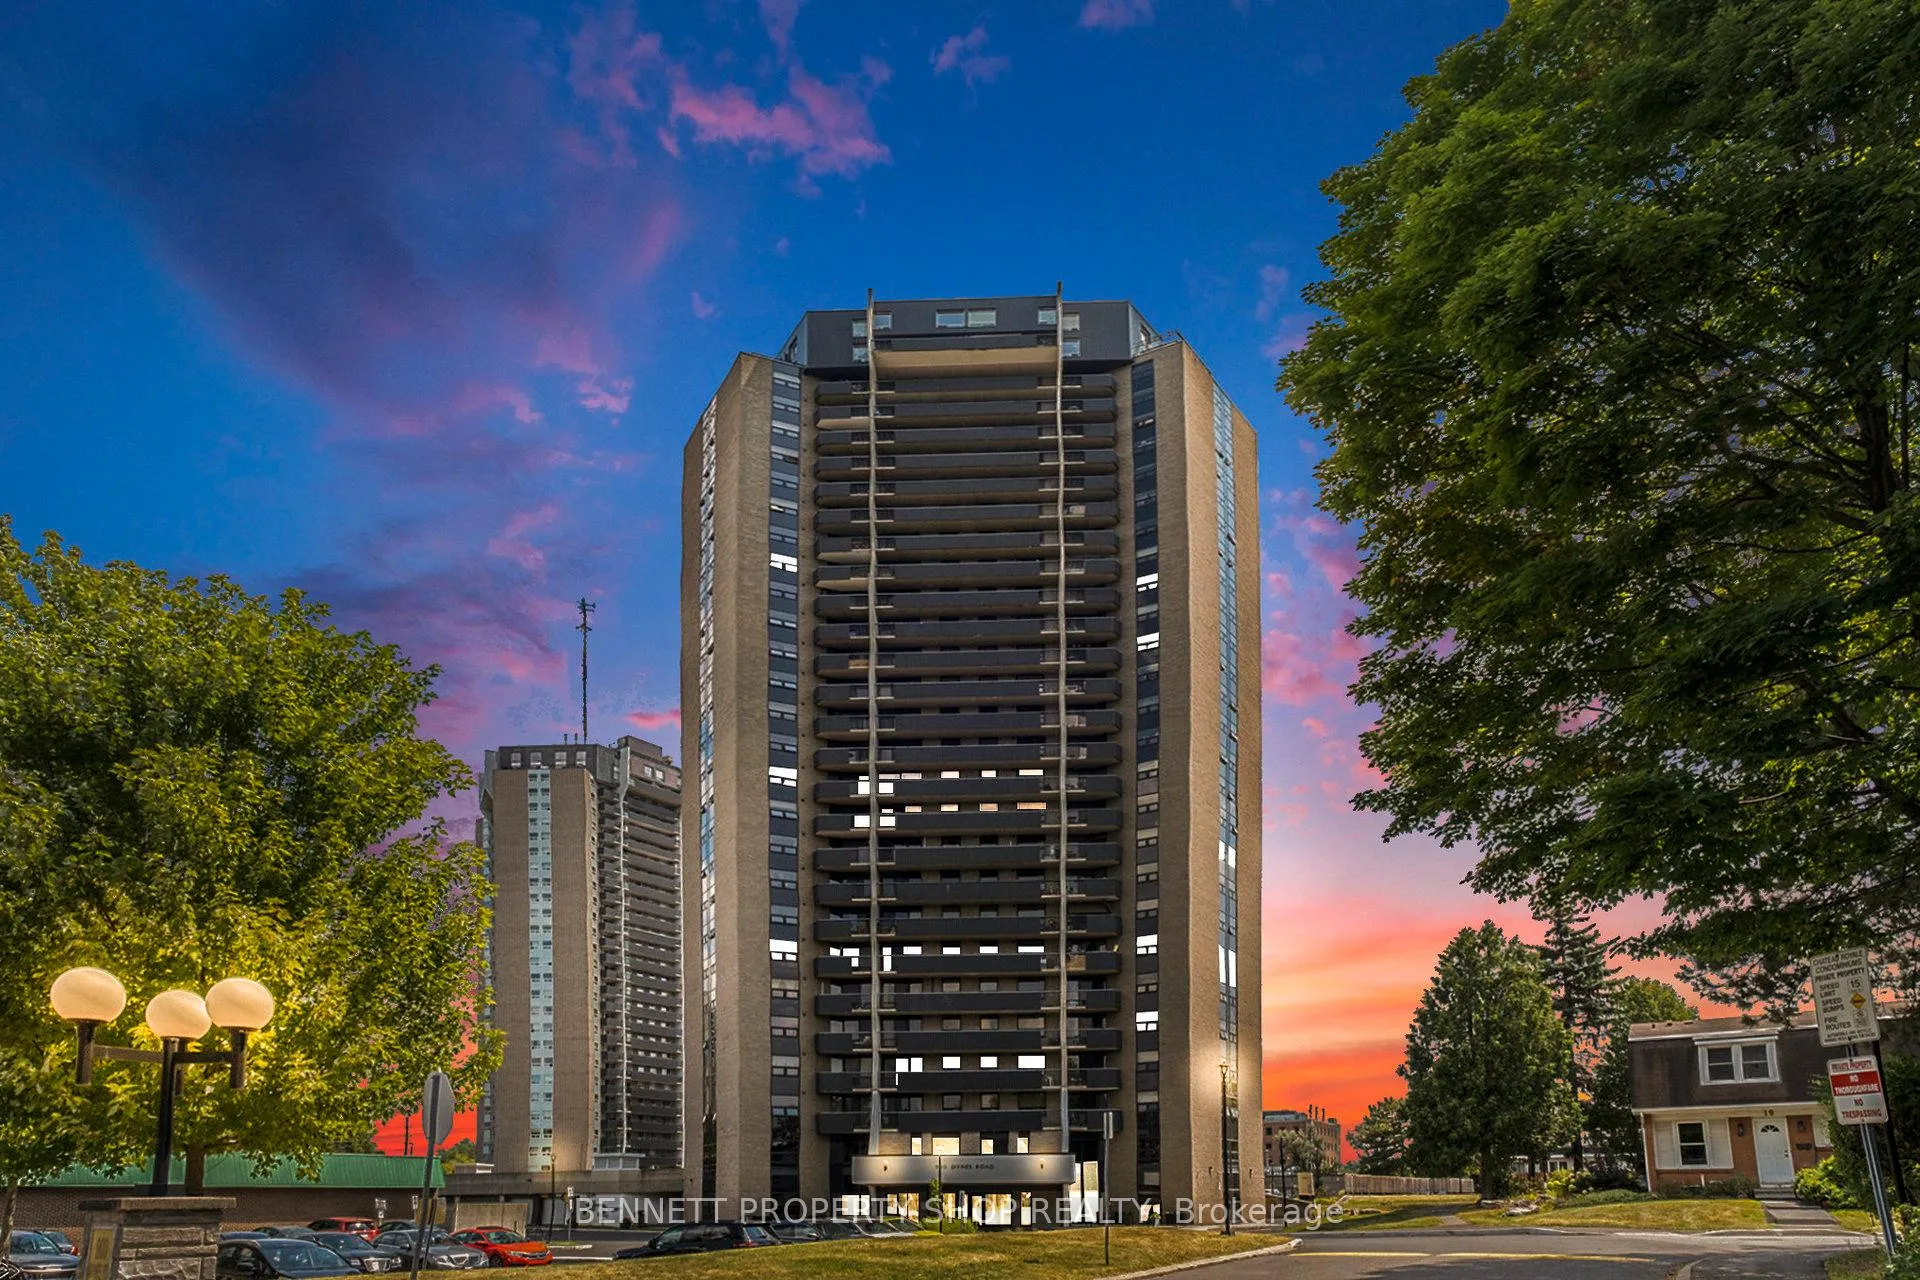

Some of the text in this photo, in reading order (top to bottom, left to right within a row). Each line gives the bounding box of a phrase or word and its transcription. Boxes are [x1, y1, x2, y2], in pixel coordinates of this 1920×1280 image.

[1815, 967, 1865, 982] PRIVATE PROPERTY
[1819, 982, 1840, 990] SPEED
[1850, 979, 1861, 989] 15
[1820, 990, 1835, 998] LIMIT
[1822, 997, 1843, 1006] SPEED
[1825, 1021, 1851, 1031] ROUTES
[1849, 1060, 1872, 1071] PROPERTY
[1849, 1074, 1859, 1082] NO
[1834, 1083, 1879, 1095] THOROUGHFARE
[1854, 1098, 1864, 1106] NO
[1842, 1109, 1882, 1118] TRESPASSING
